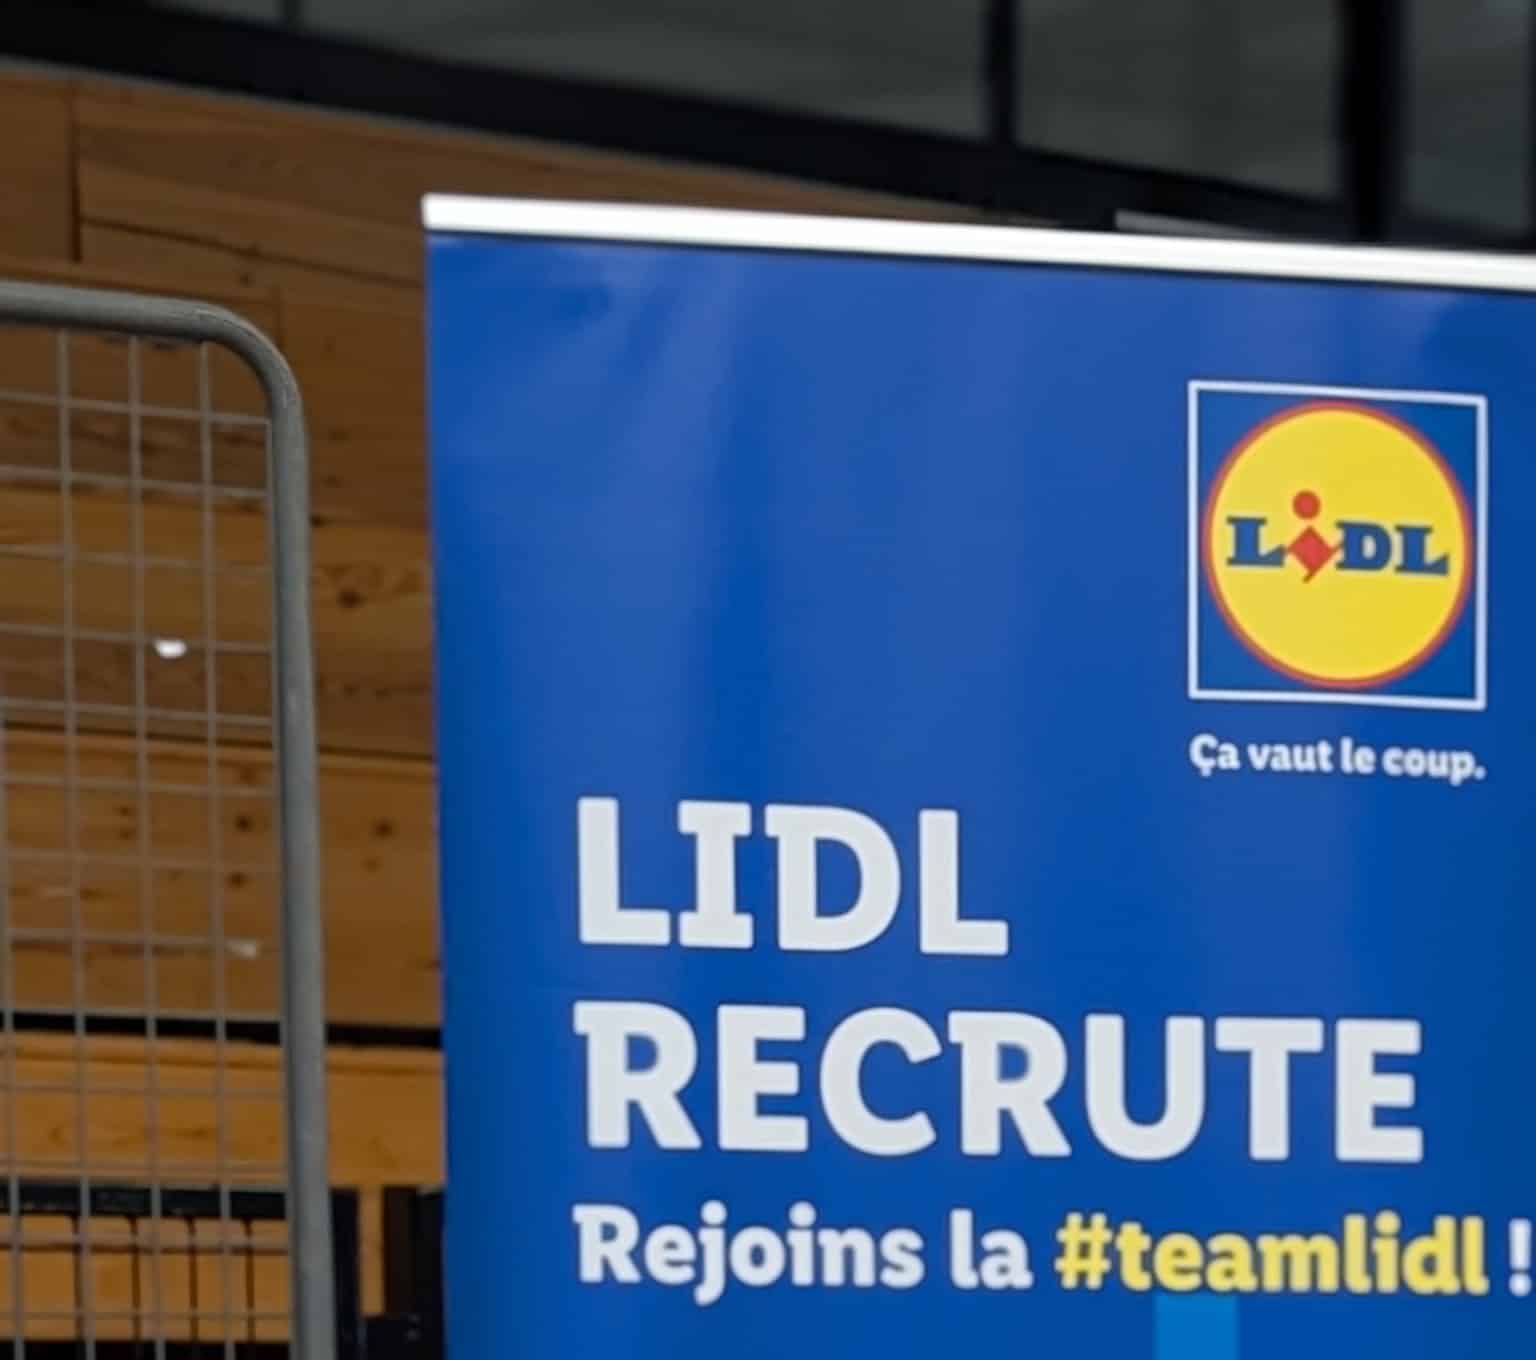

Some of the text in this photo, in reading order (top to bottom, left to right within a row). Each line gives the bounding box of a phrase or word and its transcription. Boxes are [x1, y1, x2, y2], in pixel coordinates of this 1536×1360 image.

[1189, 733, 1487, 786] Ça vaut le coup.
[577, 796, 1009, 956] LIDL
[573, 1001, 1423, 1163] RECRUTE
[572, 1201, 1532, 1306] Rejoins la #teamlidl !
